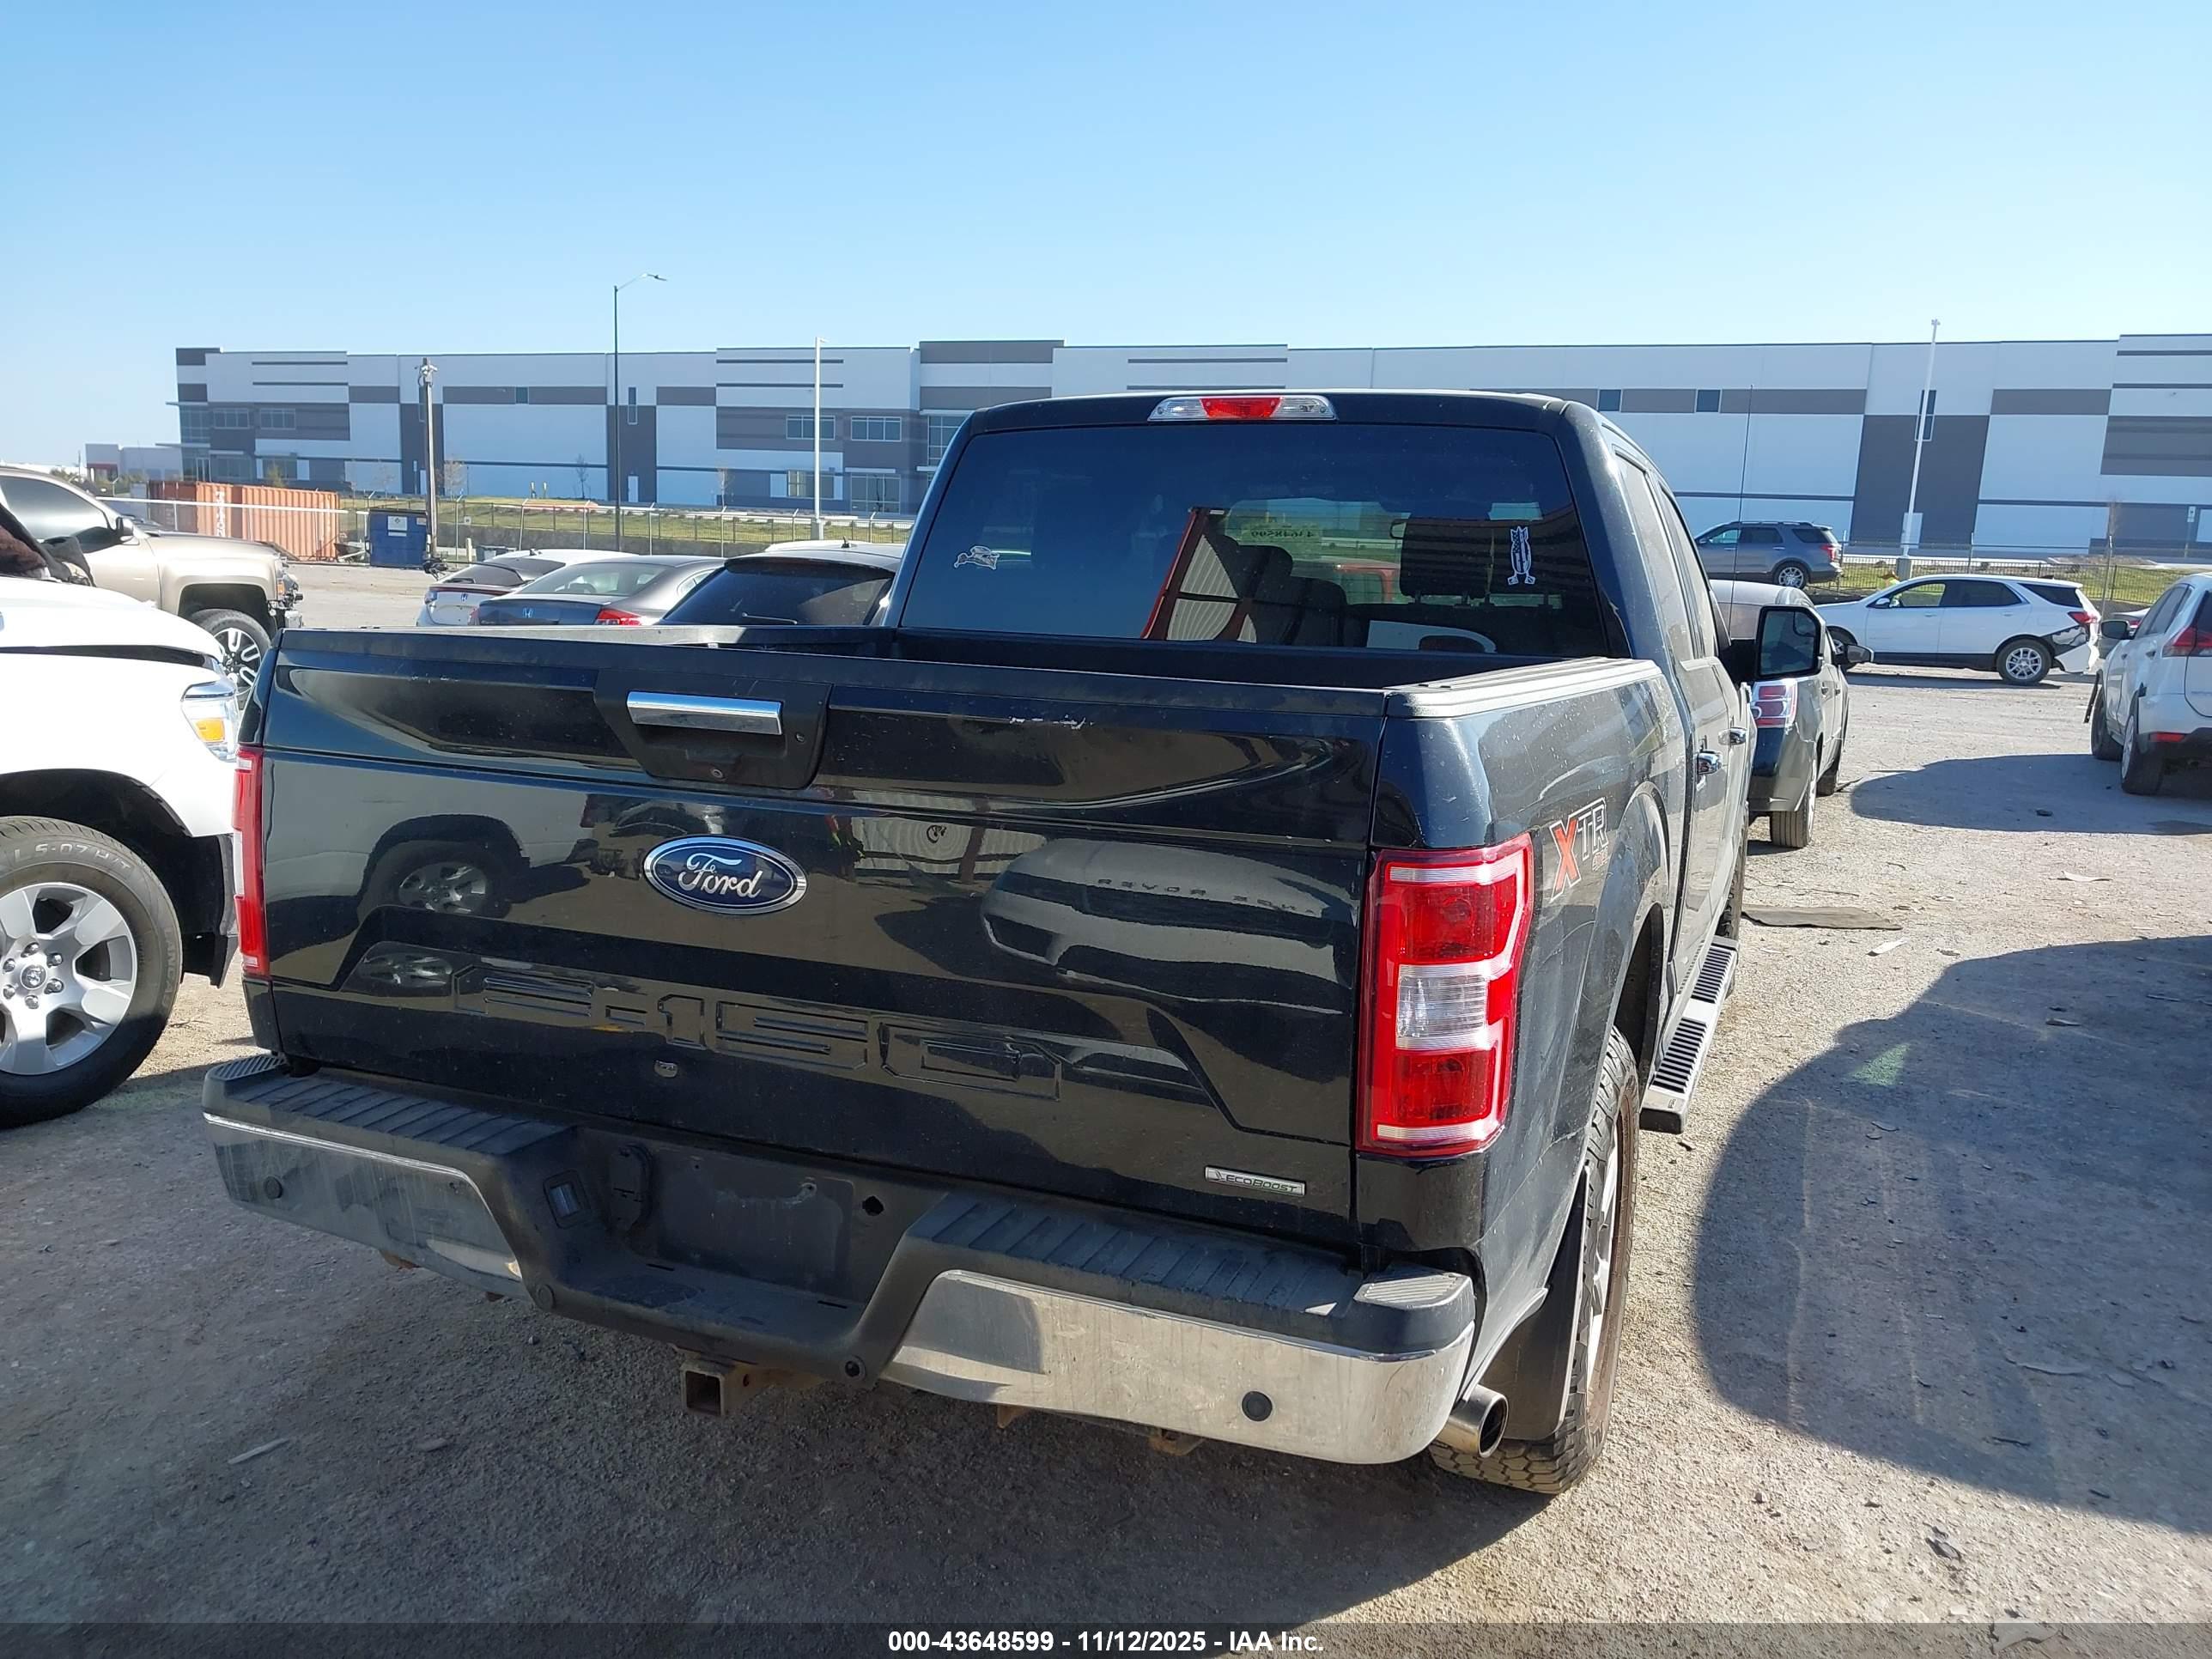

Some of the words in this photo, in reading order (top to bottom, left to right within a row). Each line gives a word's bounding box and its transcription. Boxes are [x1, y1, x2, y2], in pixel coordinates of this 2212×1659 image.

[678, 852, 763, 899] Ford
[1549, 797, 1609, 904] XTR
[453, 962, 1063, 1103] F-150
